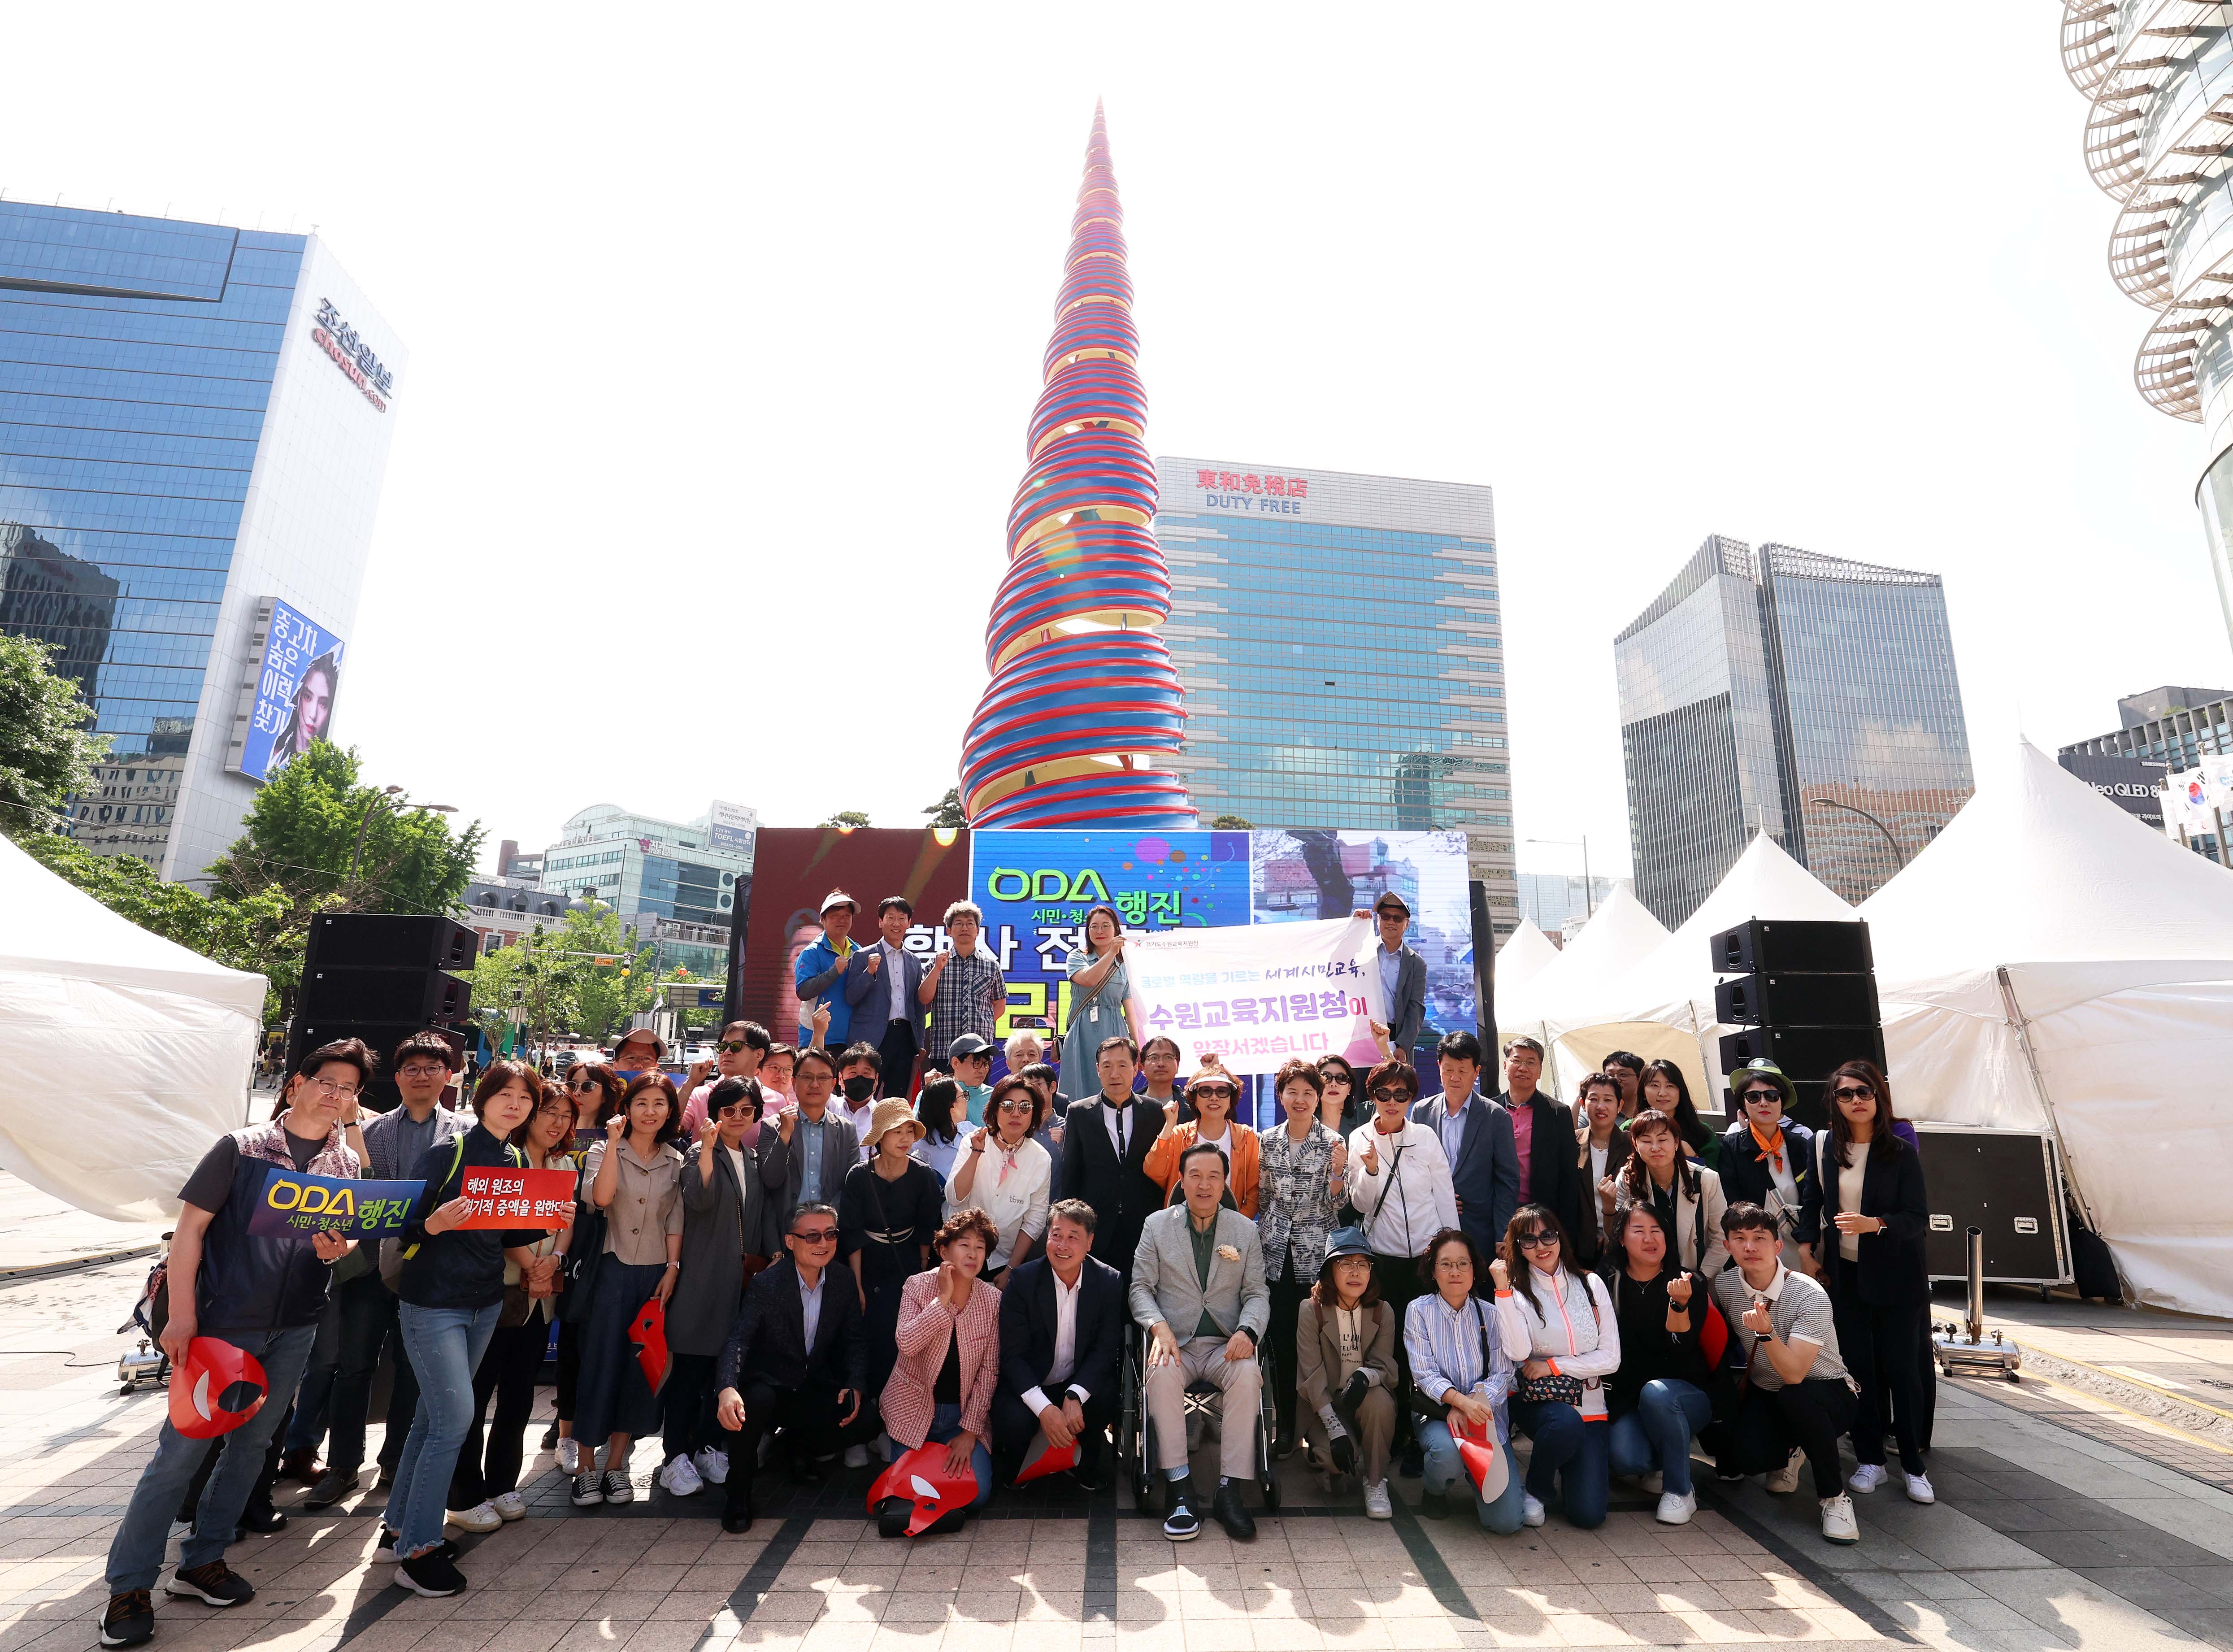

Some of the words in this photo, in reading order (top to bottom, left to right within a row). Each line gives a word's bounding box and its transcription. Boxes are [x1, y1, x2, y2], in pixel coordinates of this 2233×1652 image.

[317, 297, 393, 399] 조선일보
[315, 328, 387, 413] chosun.com
[1207, 494, 1252, 509] DUTY
[1260, 498, 1301, 514] FREE
[274, 607, 318, 657] 중고차
[267, 640, 300, 678] 숨은
[261, 669, 296, 708] 이력
[254, 699, 289, 735] 찾기
[2114, 783, 2149, 797] QLED
[2150, 785, 2160, 798] 8
[714, 832, 734, 842] TOEFL
[988, 866, 1111, 901] ODA
[1031, 909, 1087, 925] 시민·청
[1114, 890, 1182, 925] 행진
[1140, 974, 1176, 988] 글로벌
[1179, 972, 1218, 987] 역량을
[1221, 969, 1261, 983] 기르는
[1149, 990, 1368, 1030] 수원교육지원청이
[268, 1178, 355, 1216] ODA
[467, 1177, 490, 1195] 해외
[491, 1178, 524, 1196] 원조의
[286, 1214, 355, 1231] 시민·청소년
[358, 1198, 412, 1230] 행진
[496, 1199, 531, 1217] 증액을
